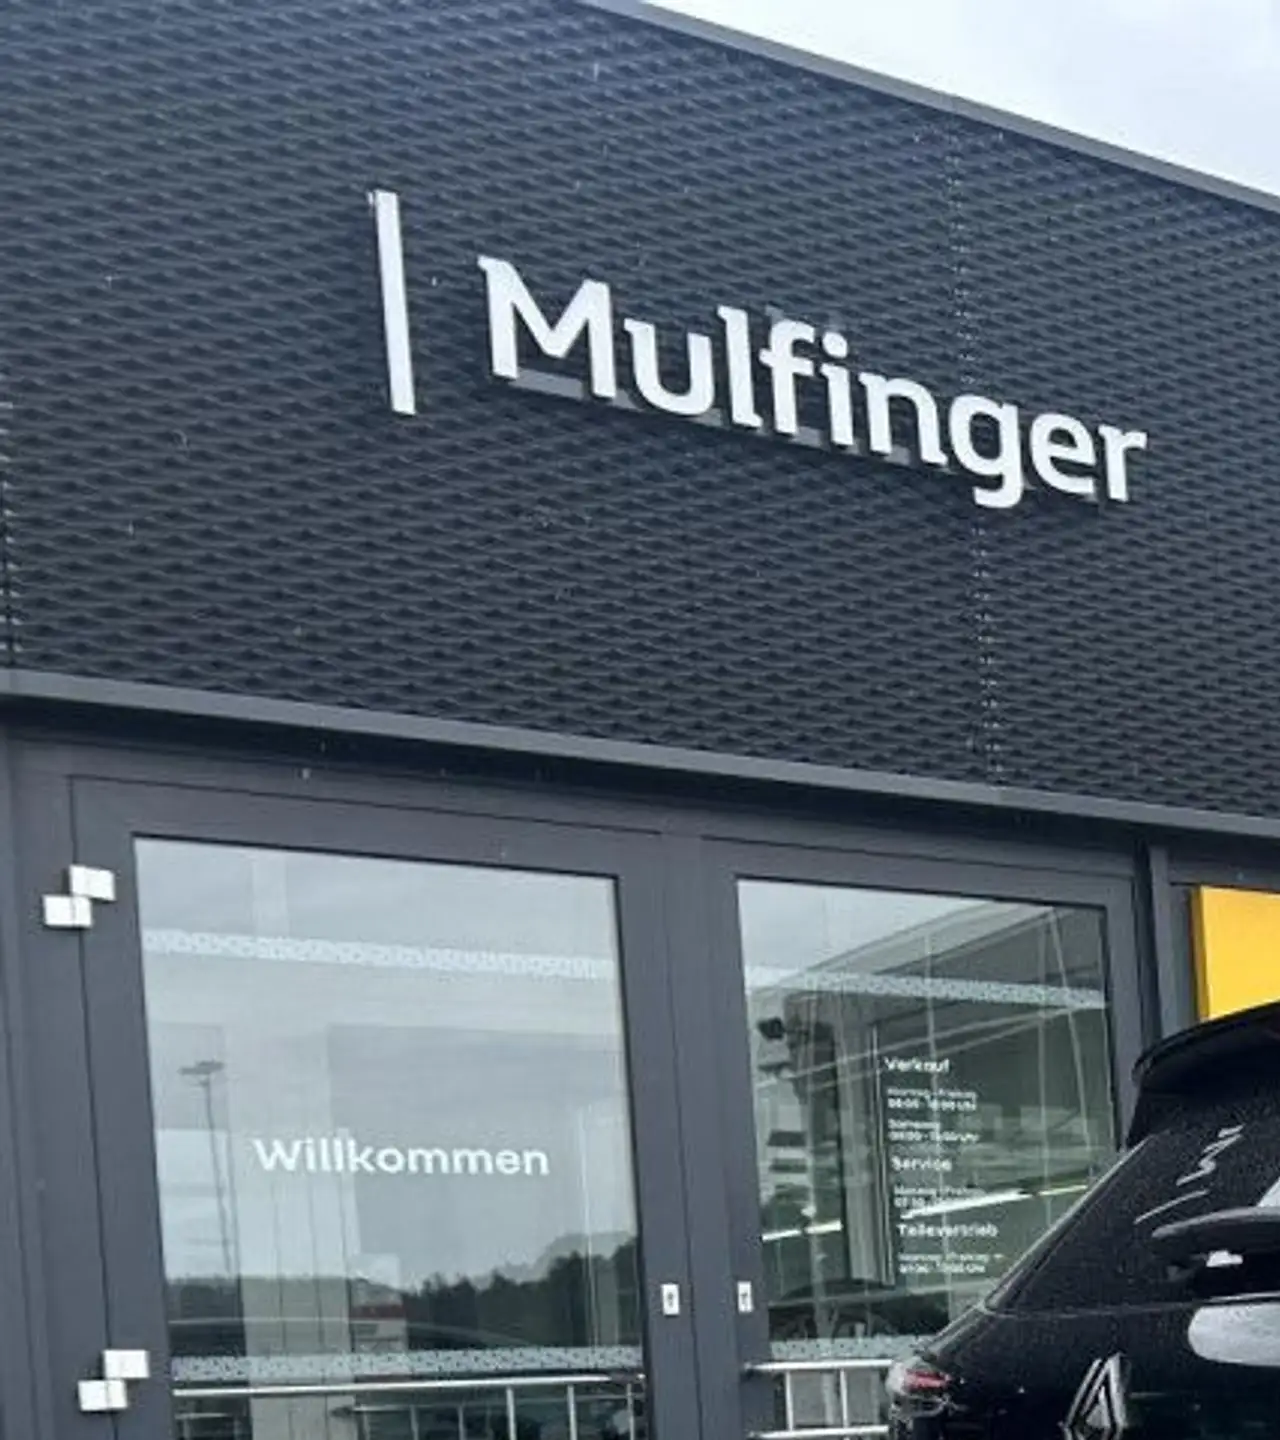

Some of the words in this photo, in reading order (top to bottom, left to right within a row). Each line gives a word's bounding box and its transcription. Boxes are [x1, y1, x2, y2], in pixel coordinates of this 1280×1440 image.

[478, 255, 1148, 509] Mulfinger
[252, 1136, 550, 1175] Willkommen
[891, 1155, 953, 1172] Service
